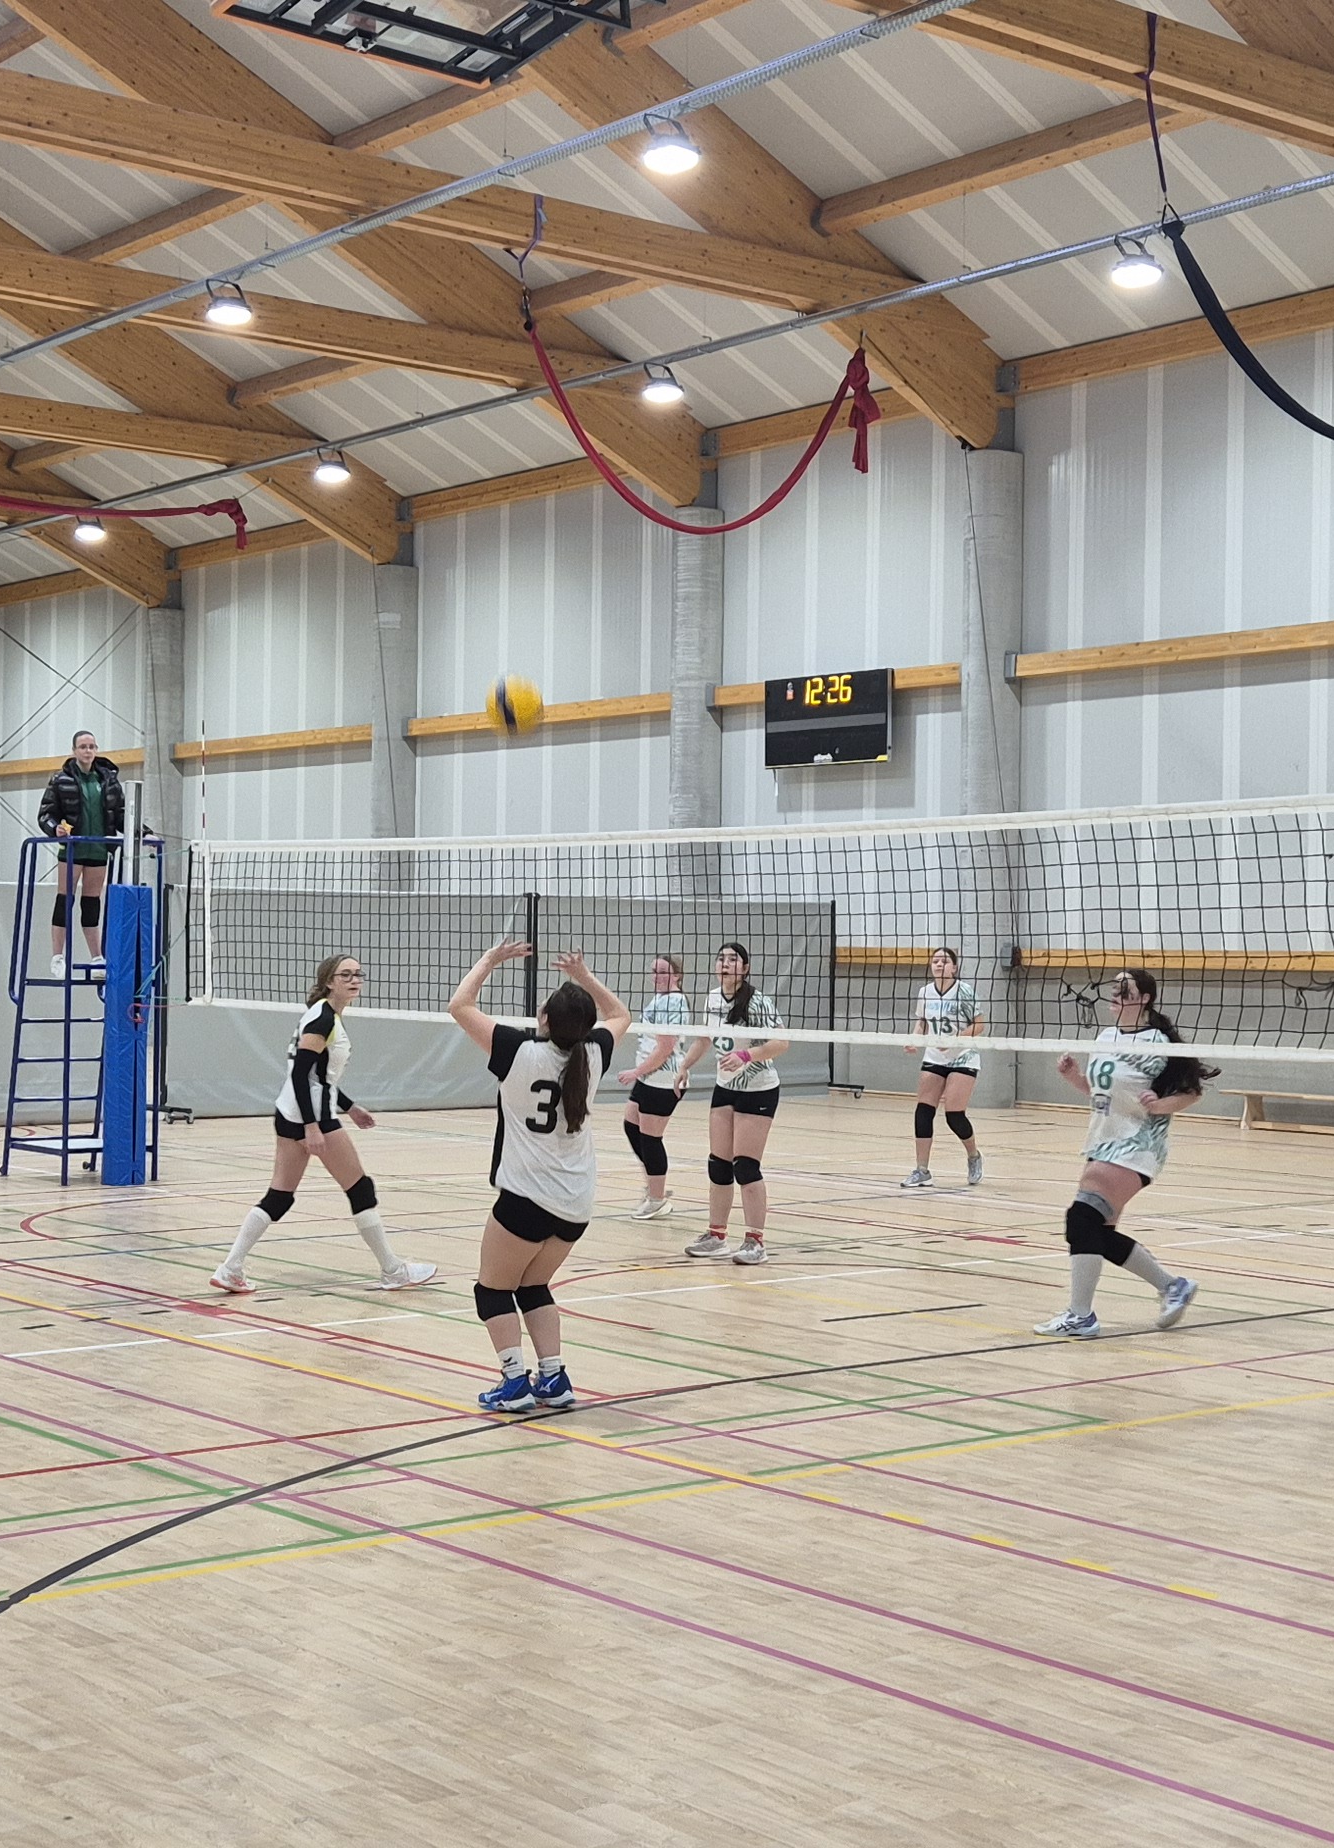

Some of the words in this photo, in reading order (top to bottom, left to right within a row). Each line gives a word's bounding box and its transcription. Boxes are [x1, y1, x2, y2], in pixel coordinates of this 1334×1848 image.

[805, 675, 852, 705] 12:26
[930, 1017, 953, 1035] 13
[1090, 1058, 1116, 1090] 18
[525, 1079, 562, 1134] 3
